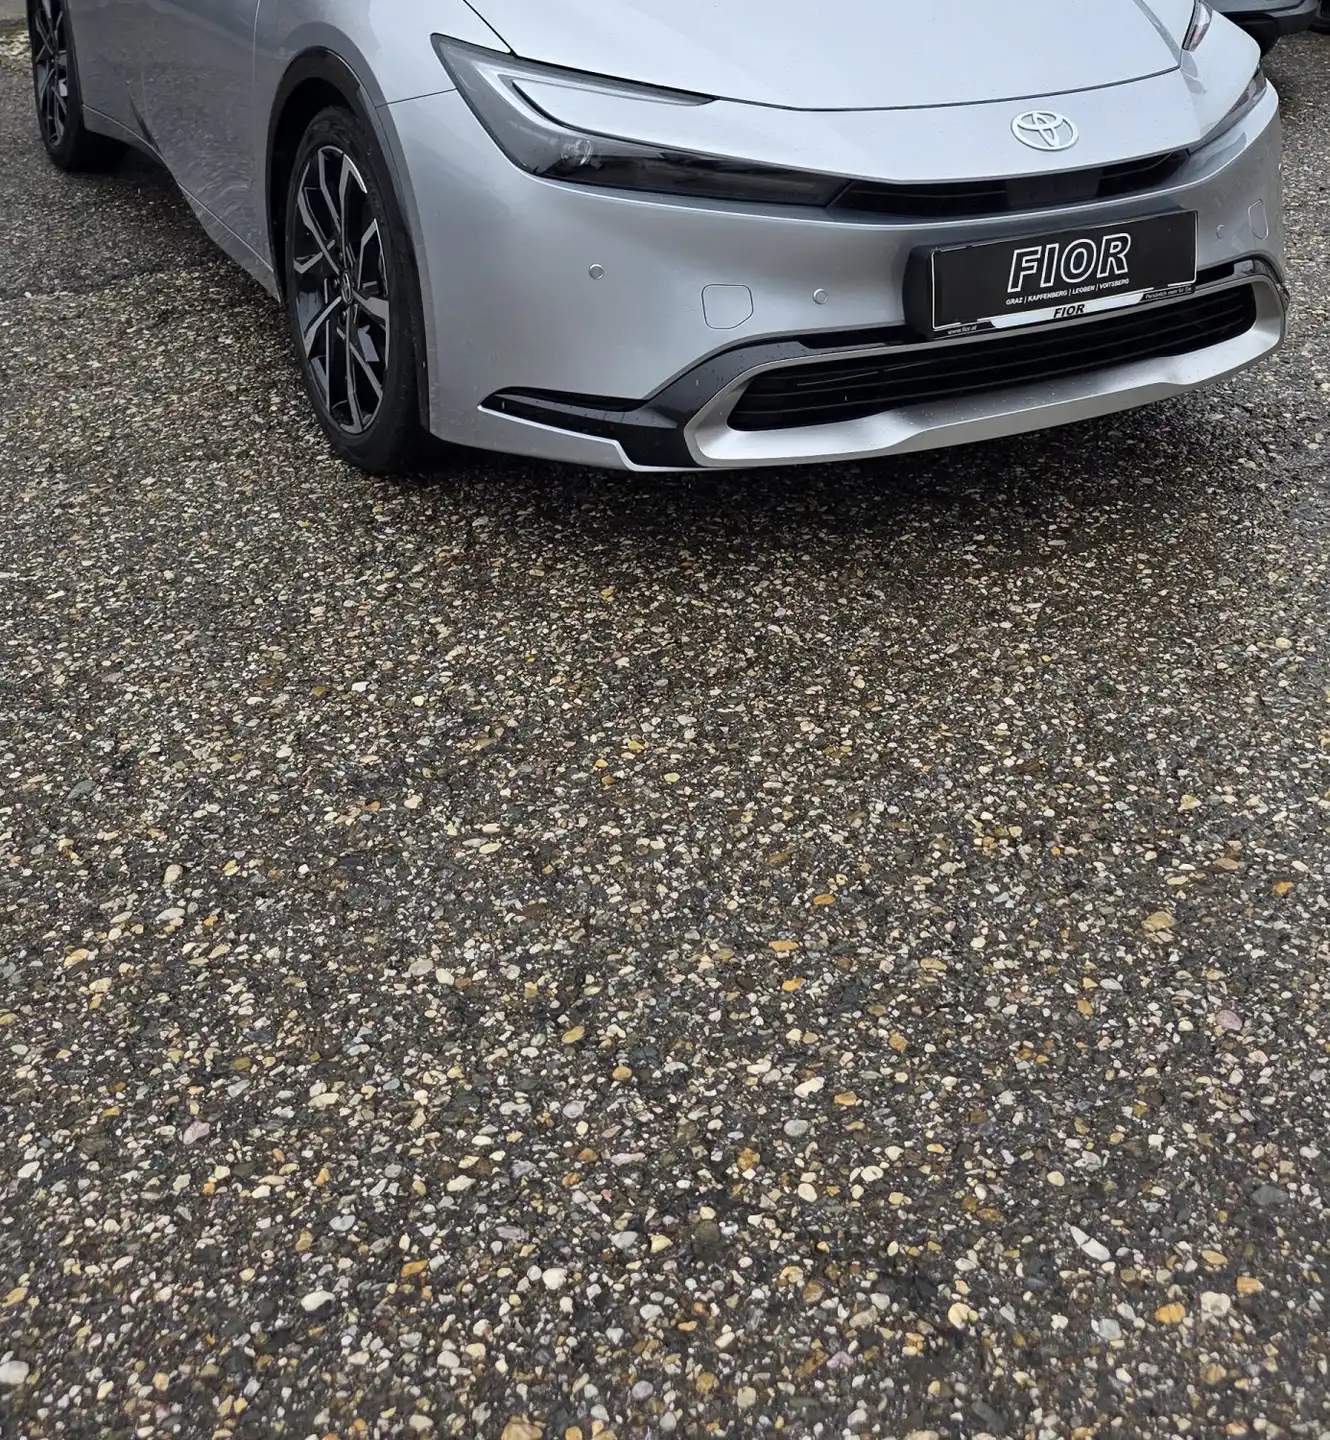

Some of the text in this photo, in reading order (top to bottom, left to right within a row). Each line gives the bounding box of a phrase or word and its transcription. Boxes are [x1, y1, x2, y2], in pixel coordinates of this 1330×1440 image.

[1007, 233, 1131, 293] FIOR
[1005, 296, 1023, 306] GRAZ
[1028, 290, 1068, 303] KAPFENBERG
[1072, 284, 1095, 295] LEOBEN
[1100, 278, 1130, 290] VOITSBERG
[1053, 303, 1085, 318] FIOR
